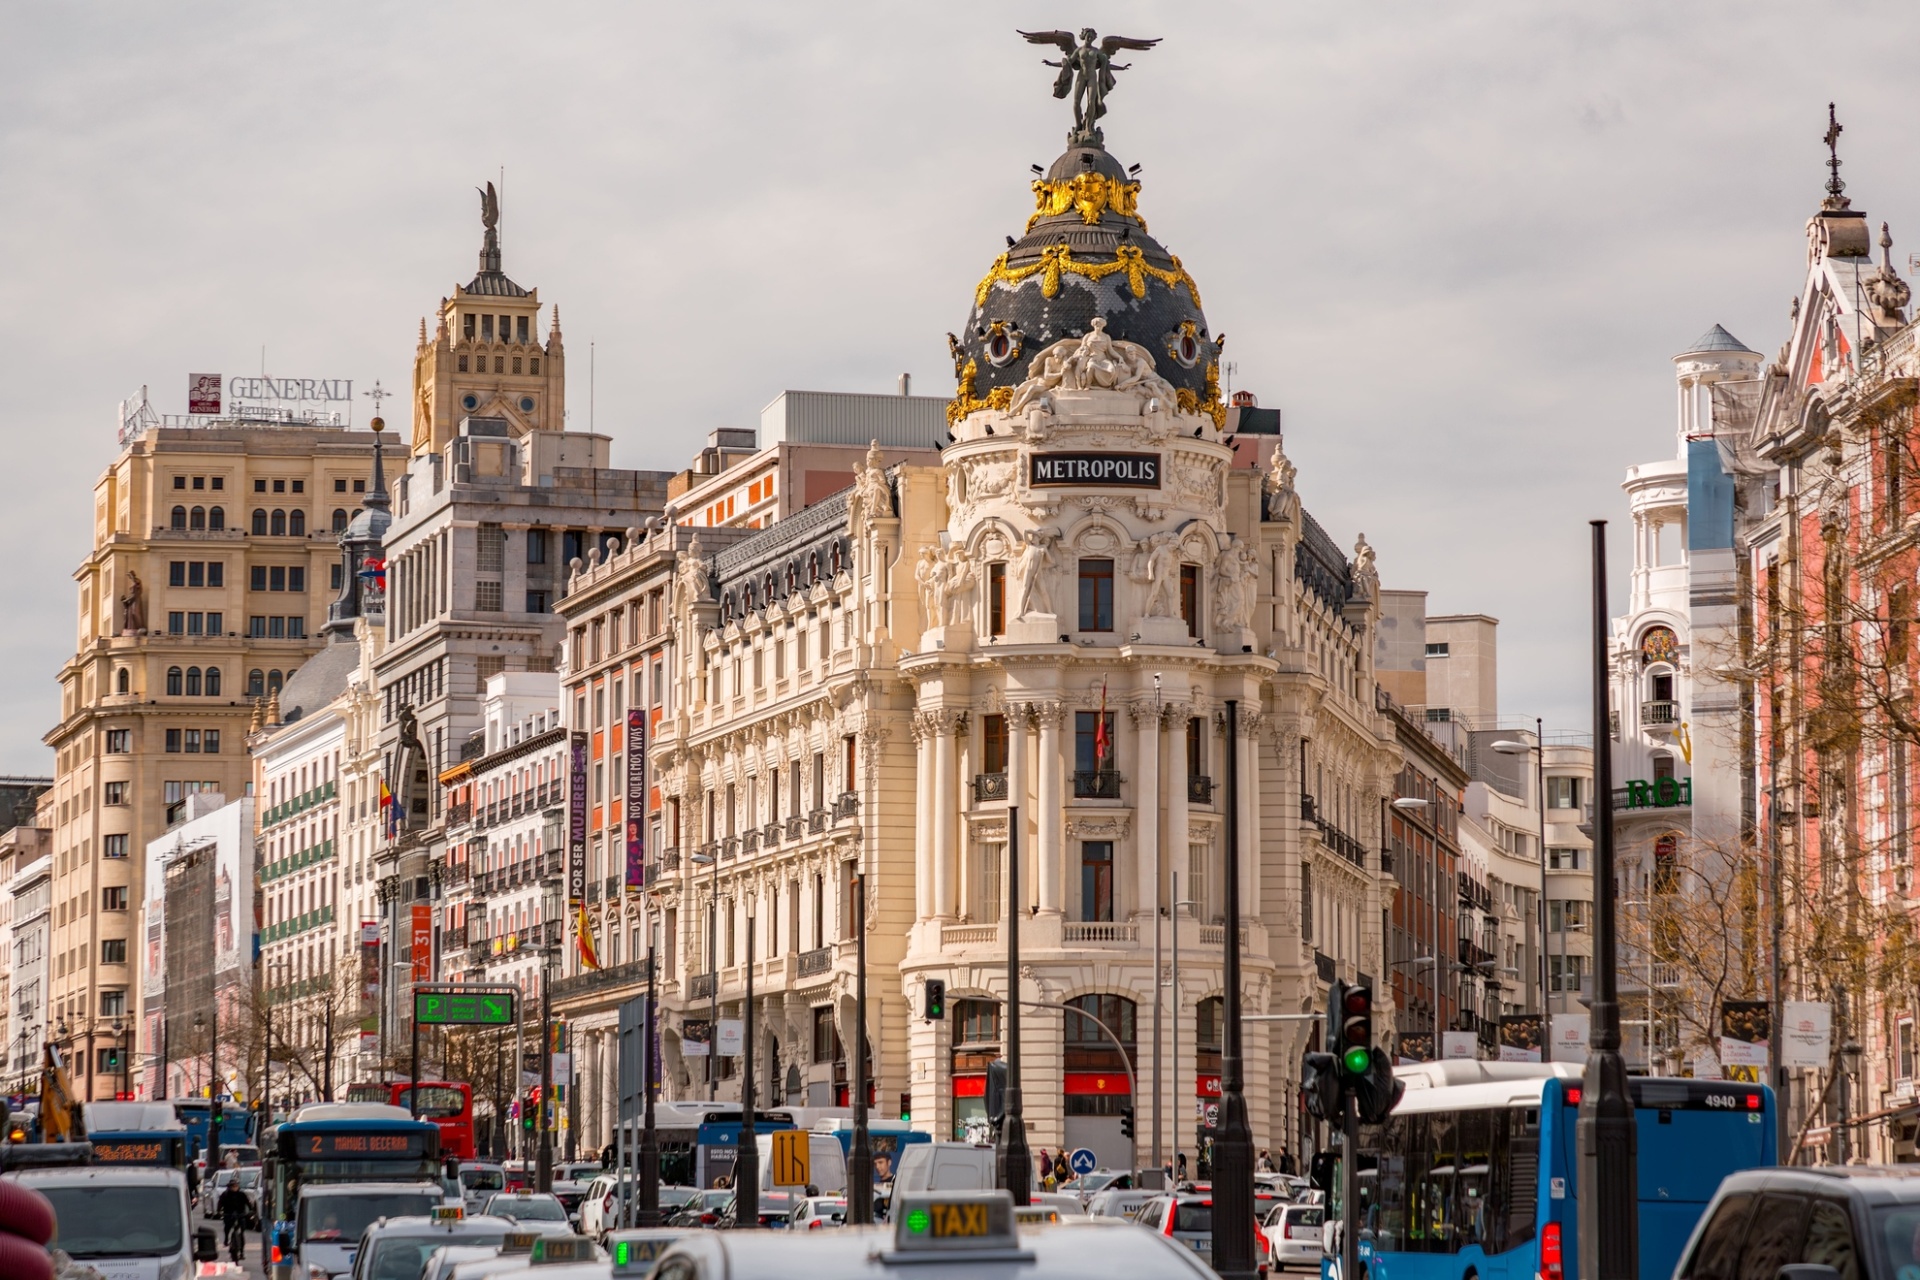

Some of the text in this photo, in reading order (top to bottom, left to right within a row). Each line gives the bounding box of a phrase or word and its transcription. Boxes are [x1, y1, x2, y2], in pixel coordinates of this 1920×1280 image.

[229, 376, 353, 401] GENERALI
[1037, 459, 1155, 480] METROPOLIS
[629, 727, 643, 819] NOS QUEREMOS VIVAS
[572, 775, 585, 897] POR SER MUJERES
[415, 929, 430, 946] 31
[427, 998, 440, 1014] P
[1705, 1094, 1736, 1108] 4940
[311, 1135, 408, 1153] 2 MANUEL BECERRA
[931, 1203, 988, 1237] TAXI
